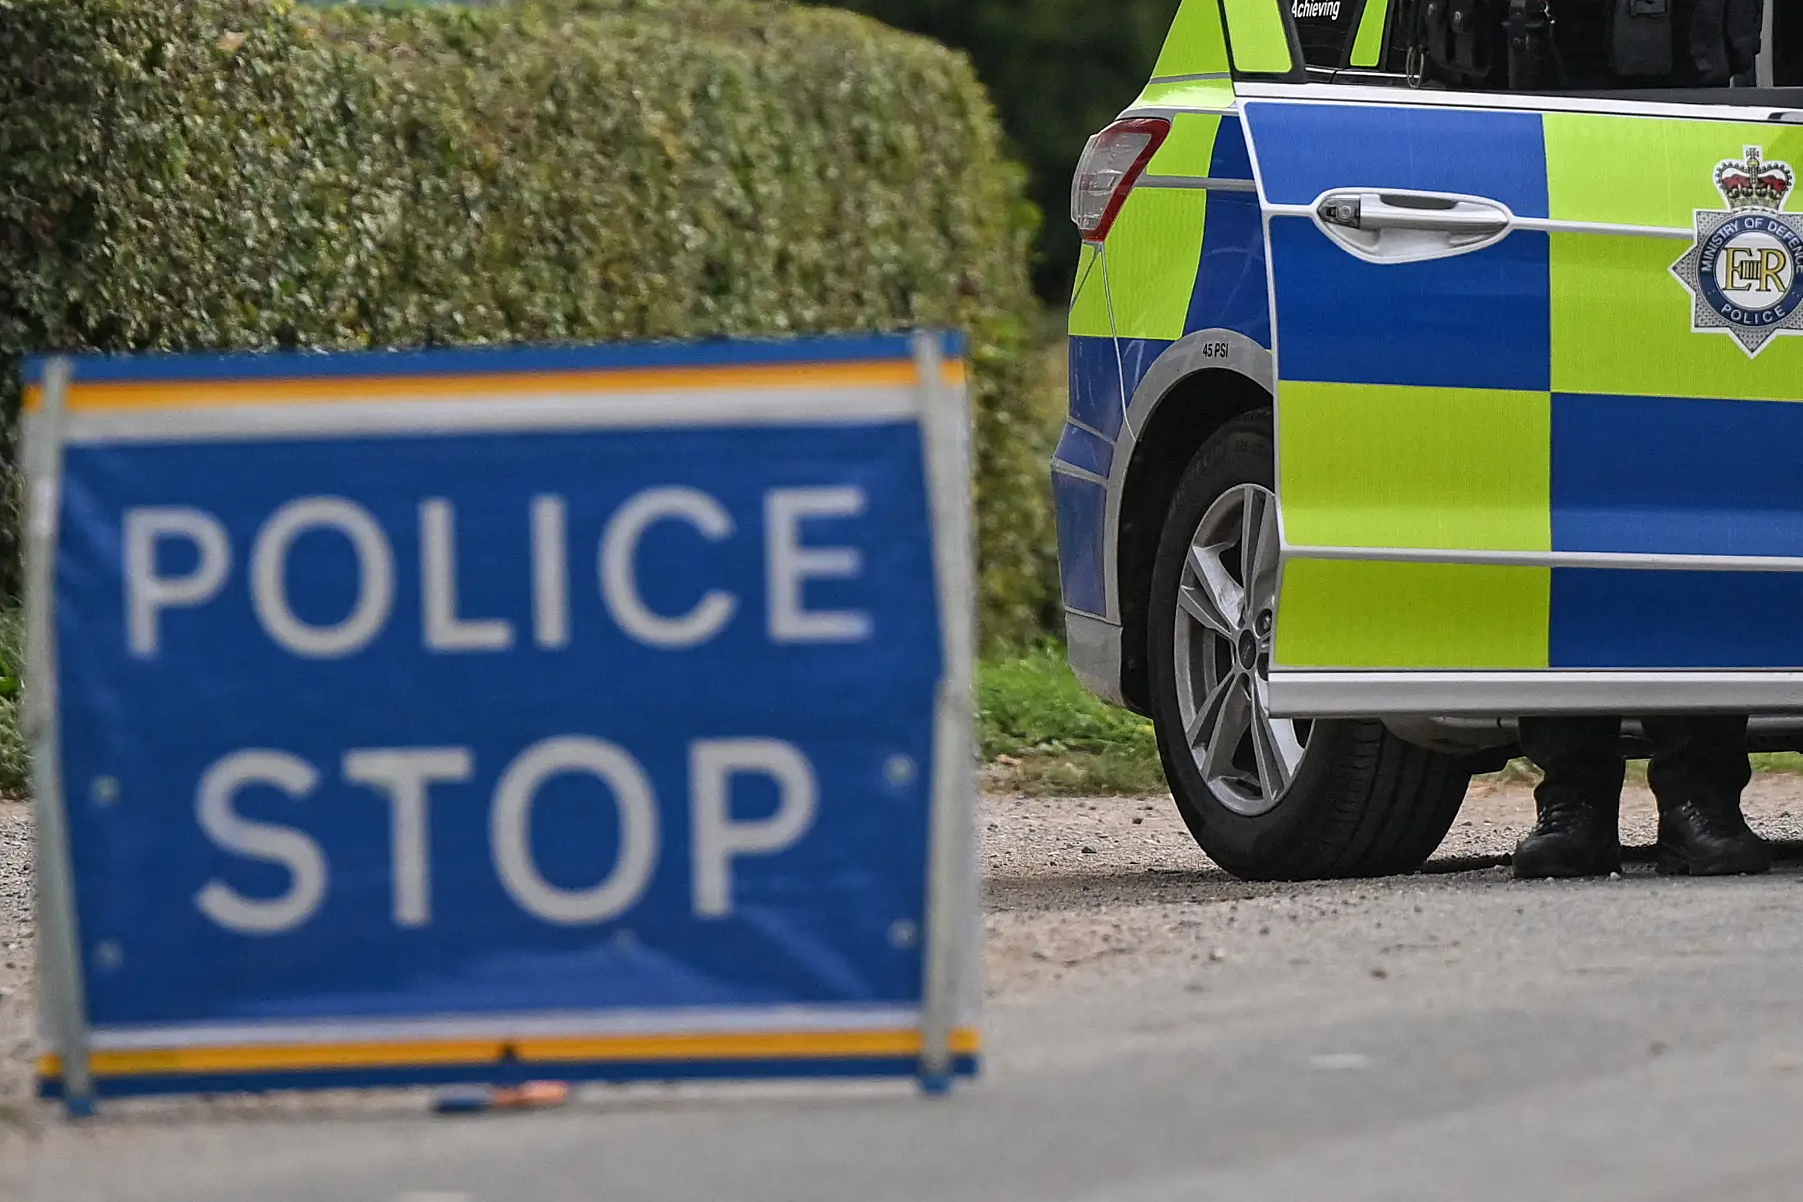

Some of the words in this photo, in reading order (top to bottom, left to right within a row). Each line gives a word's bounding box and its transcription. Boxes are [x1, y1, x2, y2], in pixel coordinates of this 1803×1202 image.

[1701, 220, 1739, 272] MINISTRY
[1744, 217, 1763, 229] OF
[1721, 303, 1786, 325] POLICE
[1202, 343, 1213, 358] 45
[1214, 342, 1229, 358] PSI
[123, 484, 873, 660] POLICE
[193, 734, 819, 935] STOP
